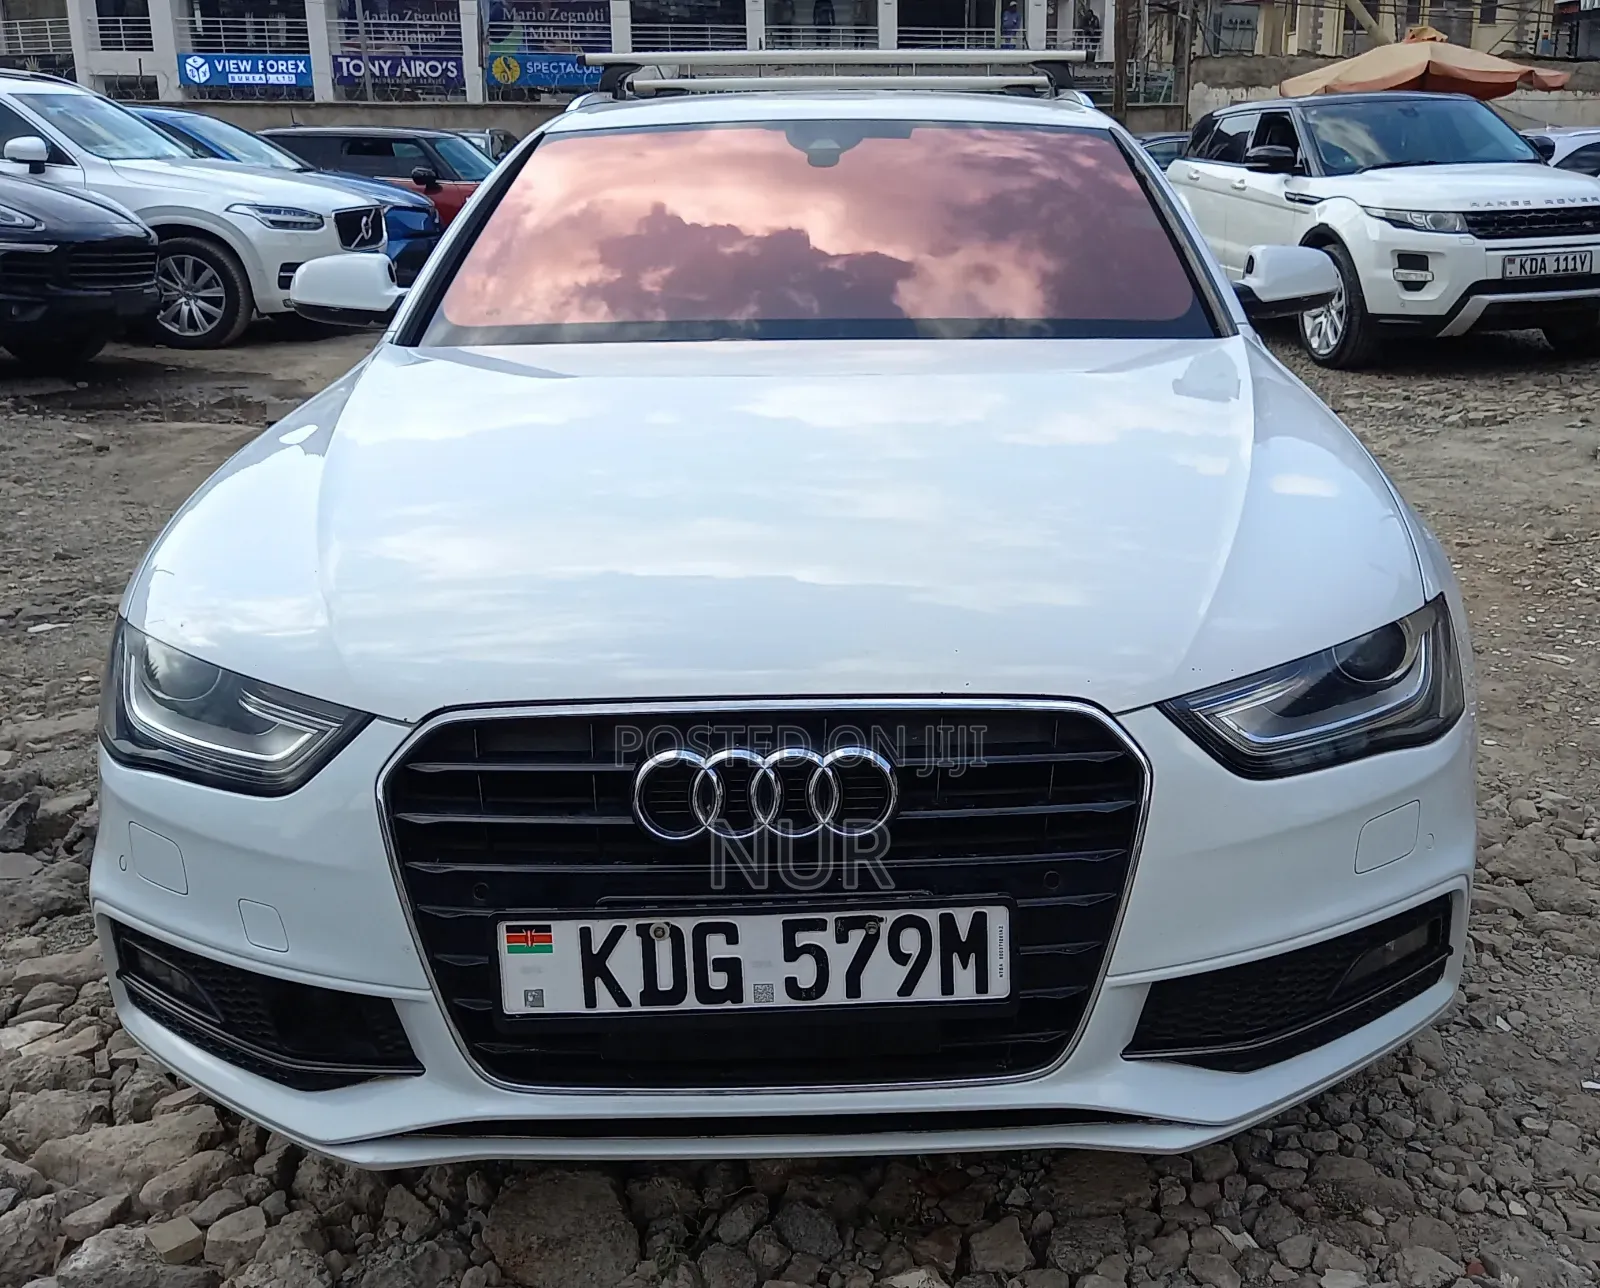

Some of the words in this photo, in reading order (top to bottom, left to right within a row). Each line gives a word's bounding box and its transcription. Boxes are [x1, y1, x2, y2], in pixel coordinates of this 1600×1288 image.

[503, 7, 546, 20] Mario
[550, 7, 604, 24] Zegnoti
[214, 59, 252, 72] VIEW
[258, 59, 307, 73] FOREX
[337, 57, 392, 77] TONY
[396, 58, 458, 78] AIRO'S
[1520, 256, 1547, 275] KDA
[1553, 253, 1588, 273] 111Y
[578, 920, 744, 1009] KDG
[781, 910, 990, 1001] 579M
